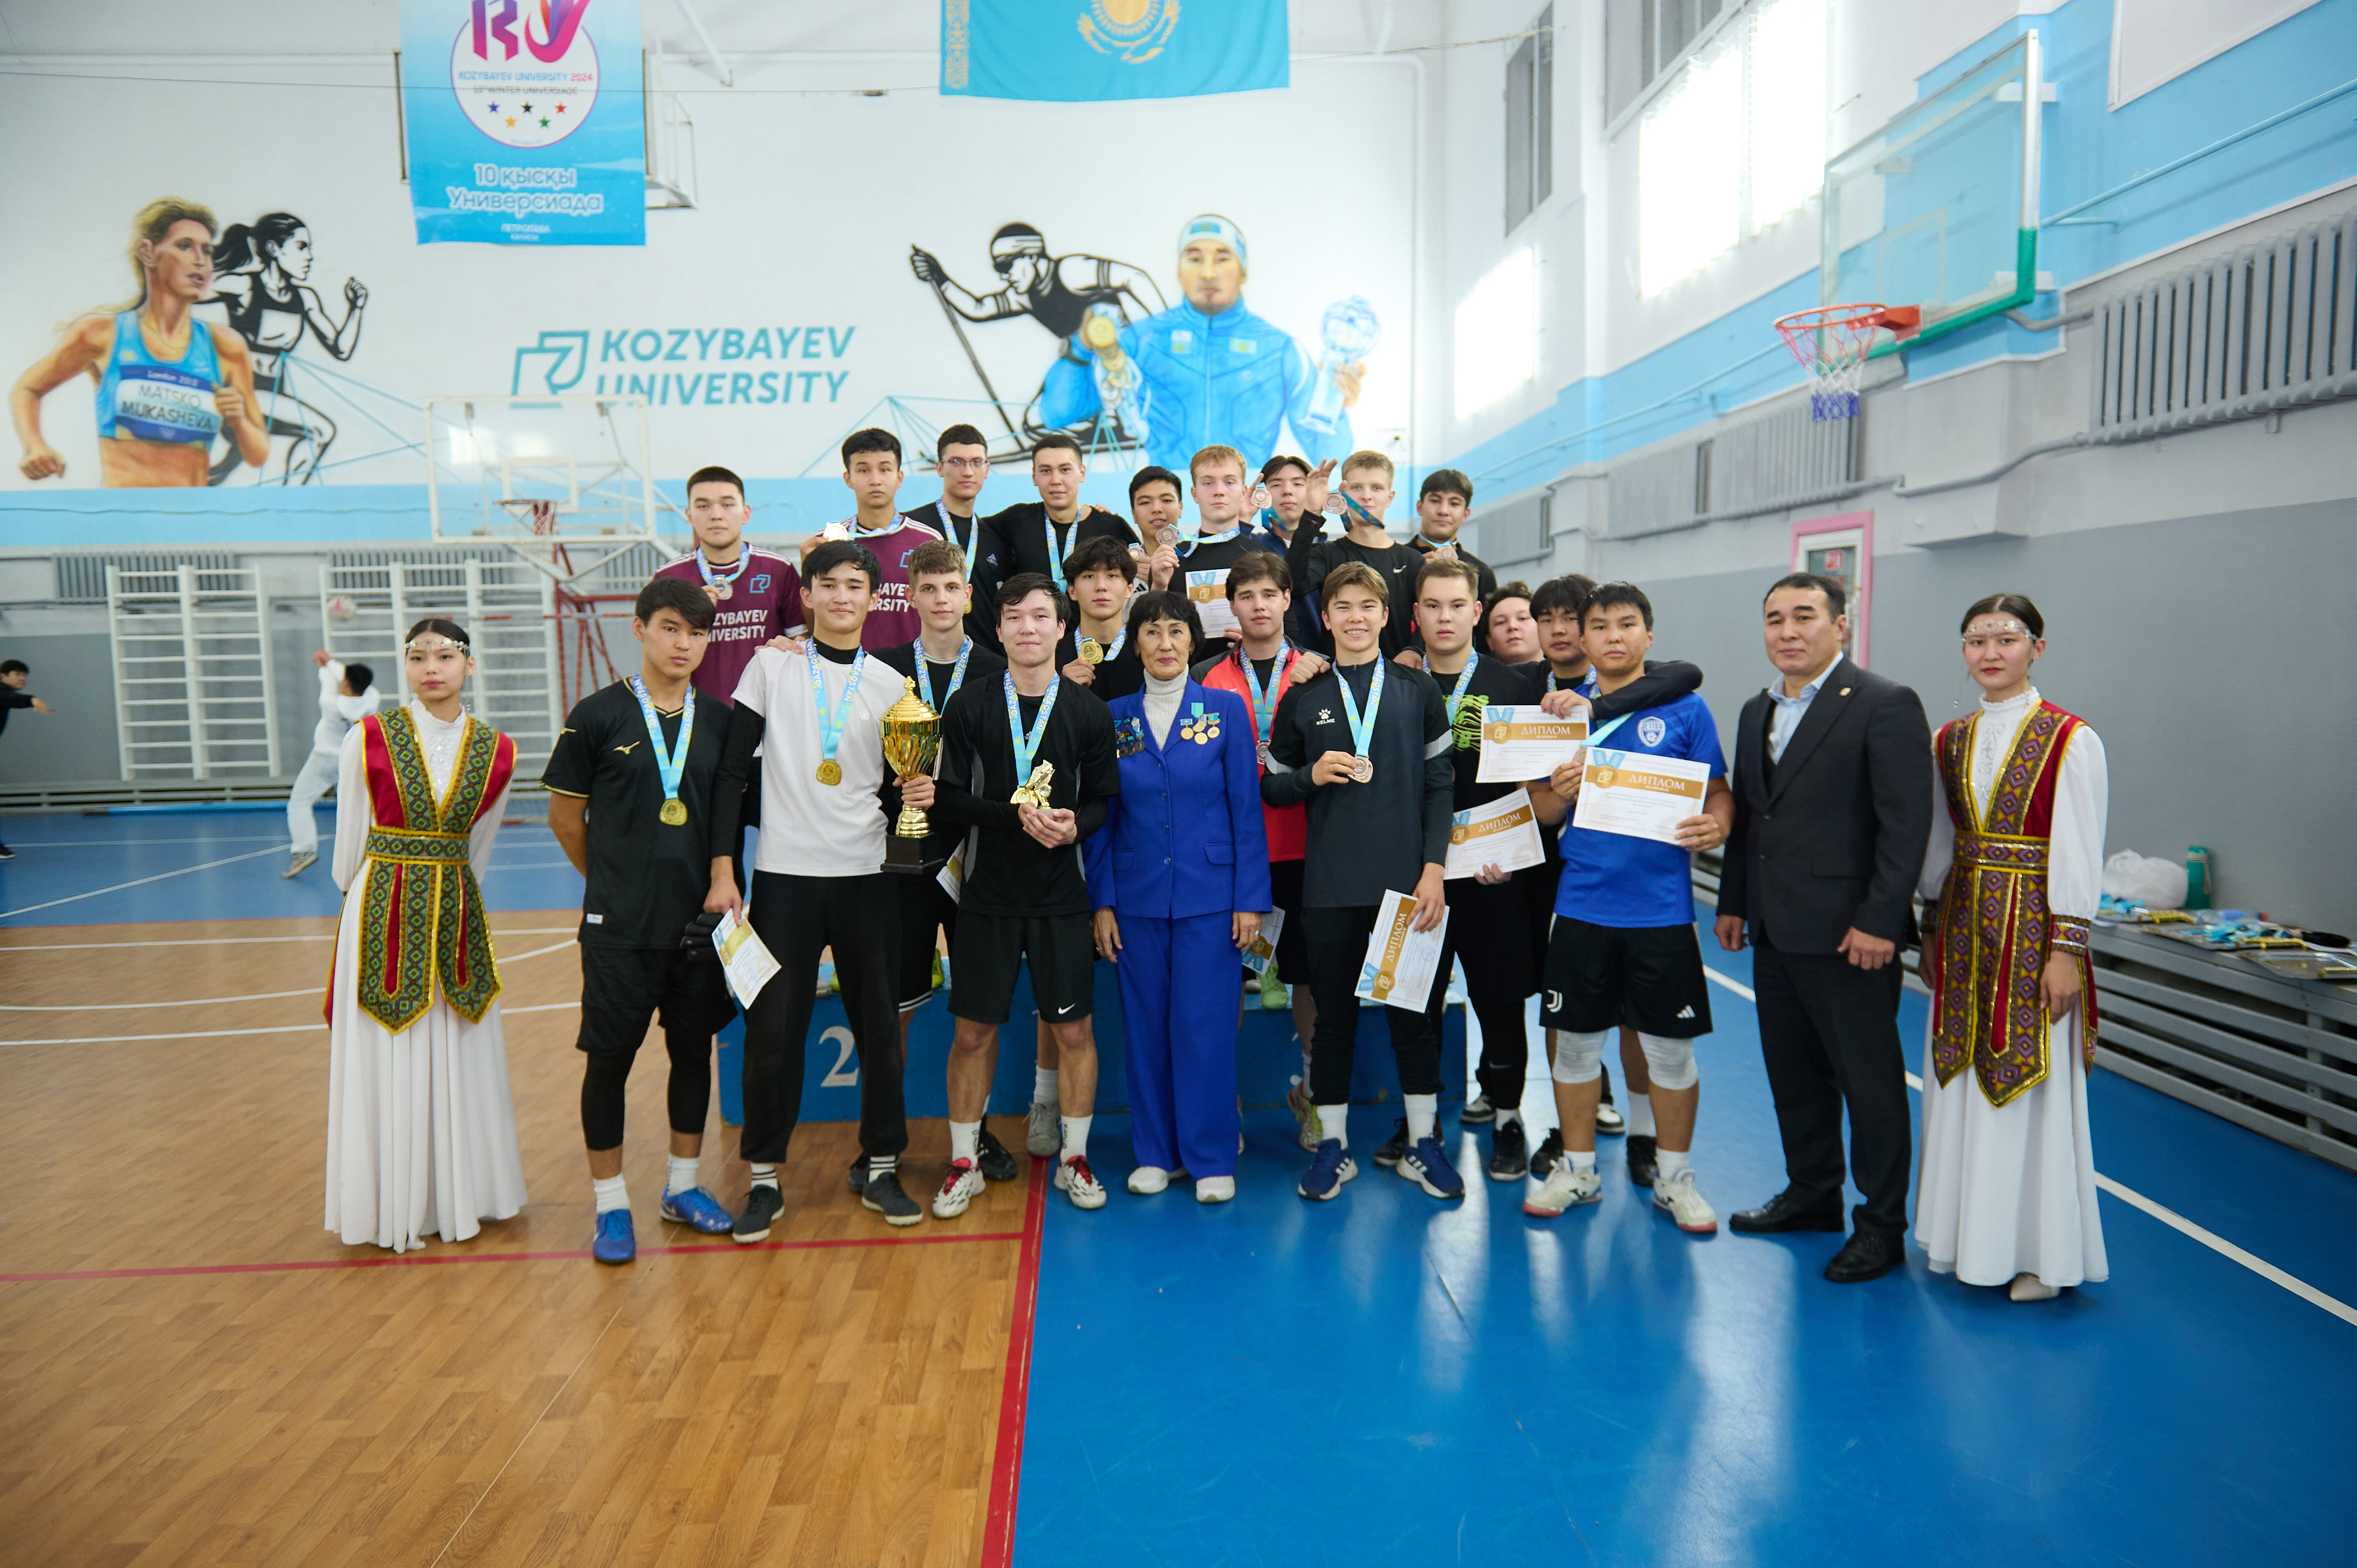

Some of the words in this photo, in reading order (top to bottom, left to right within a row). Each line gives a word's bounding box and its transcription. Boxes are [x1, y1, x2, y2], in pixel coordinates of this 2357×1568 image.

[458, 71, 512, 80] KOZYBAYEV
[515, 72, 567, 81] UNIVERSITY
[570, 73, 593, 82] 2024
[476, 164, 497, 184] 10
[448, 188, 602, 217] Универсиада
[600, 326, 857, 362] KOZYBAYEV
[139, 385, 200, 408] MATSKO
[596, 370, 850, 406] UNIVERSITY
[121, 401, 211, 431] MUKASHEVA
[713, 609, 768, 626] ZYBAYEV
[707, 625, 766, 642] IVERSITY
[1521, 725, 1571, 735] ДИПЛОМ
[1628, 774, 1686, 791] ДИПЛОМ
[1478, 812, 1521, 833] ДИПЛОМ
[1386, 913, 1408, 963] ДИПЛОМ
[819, 1025, 859, 1088] 2
